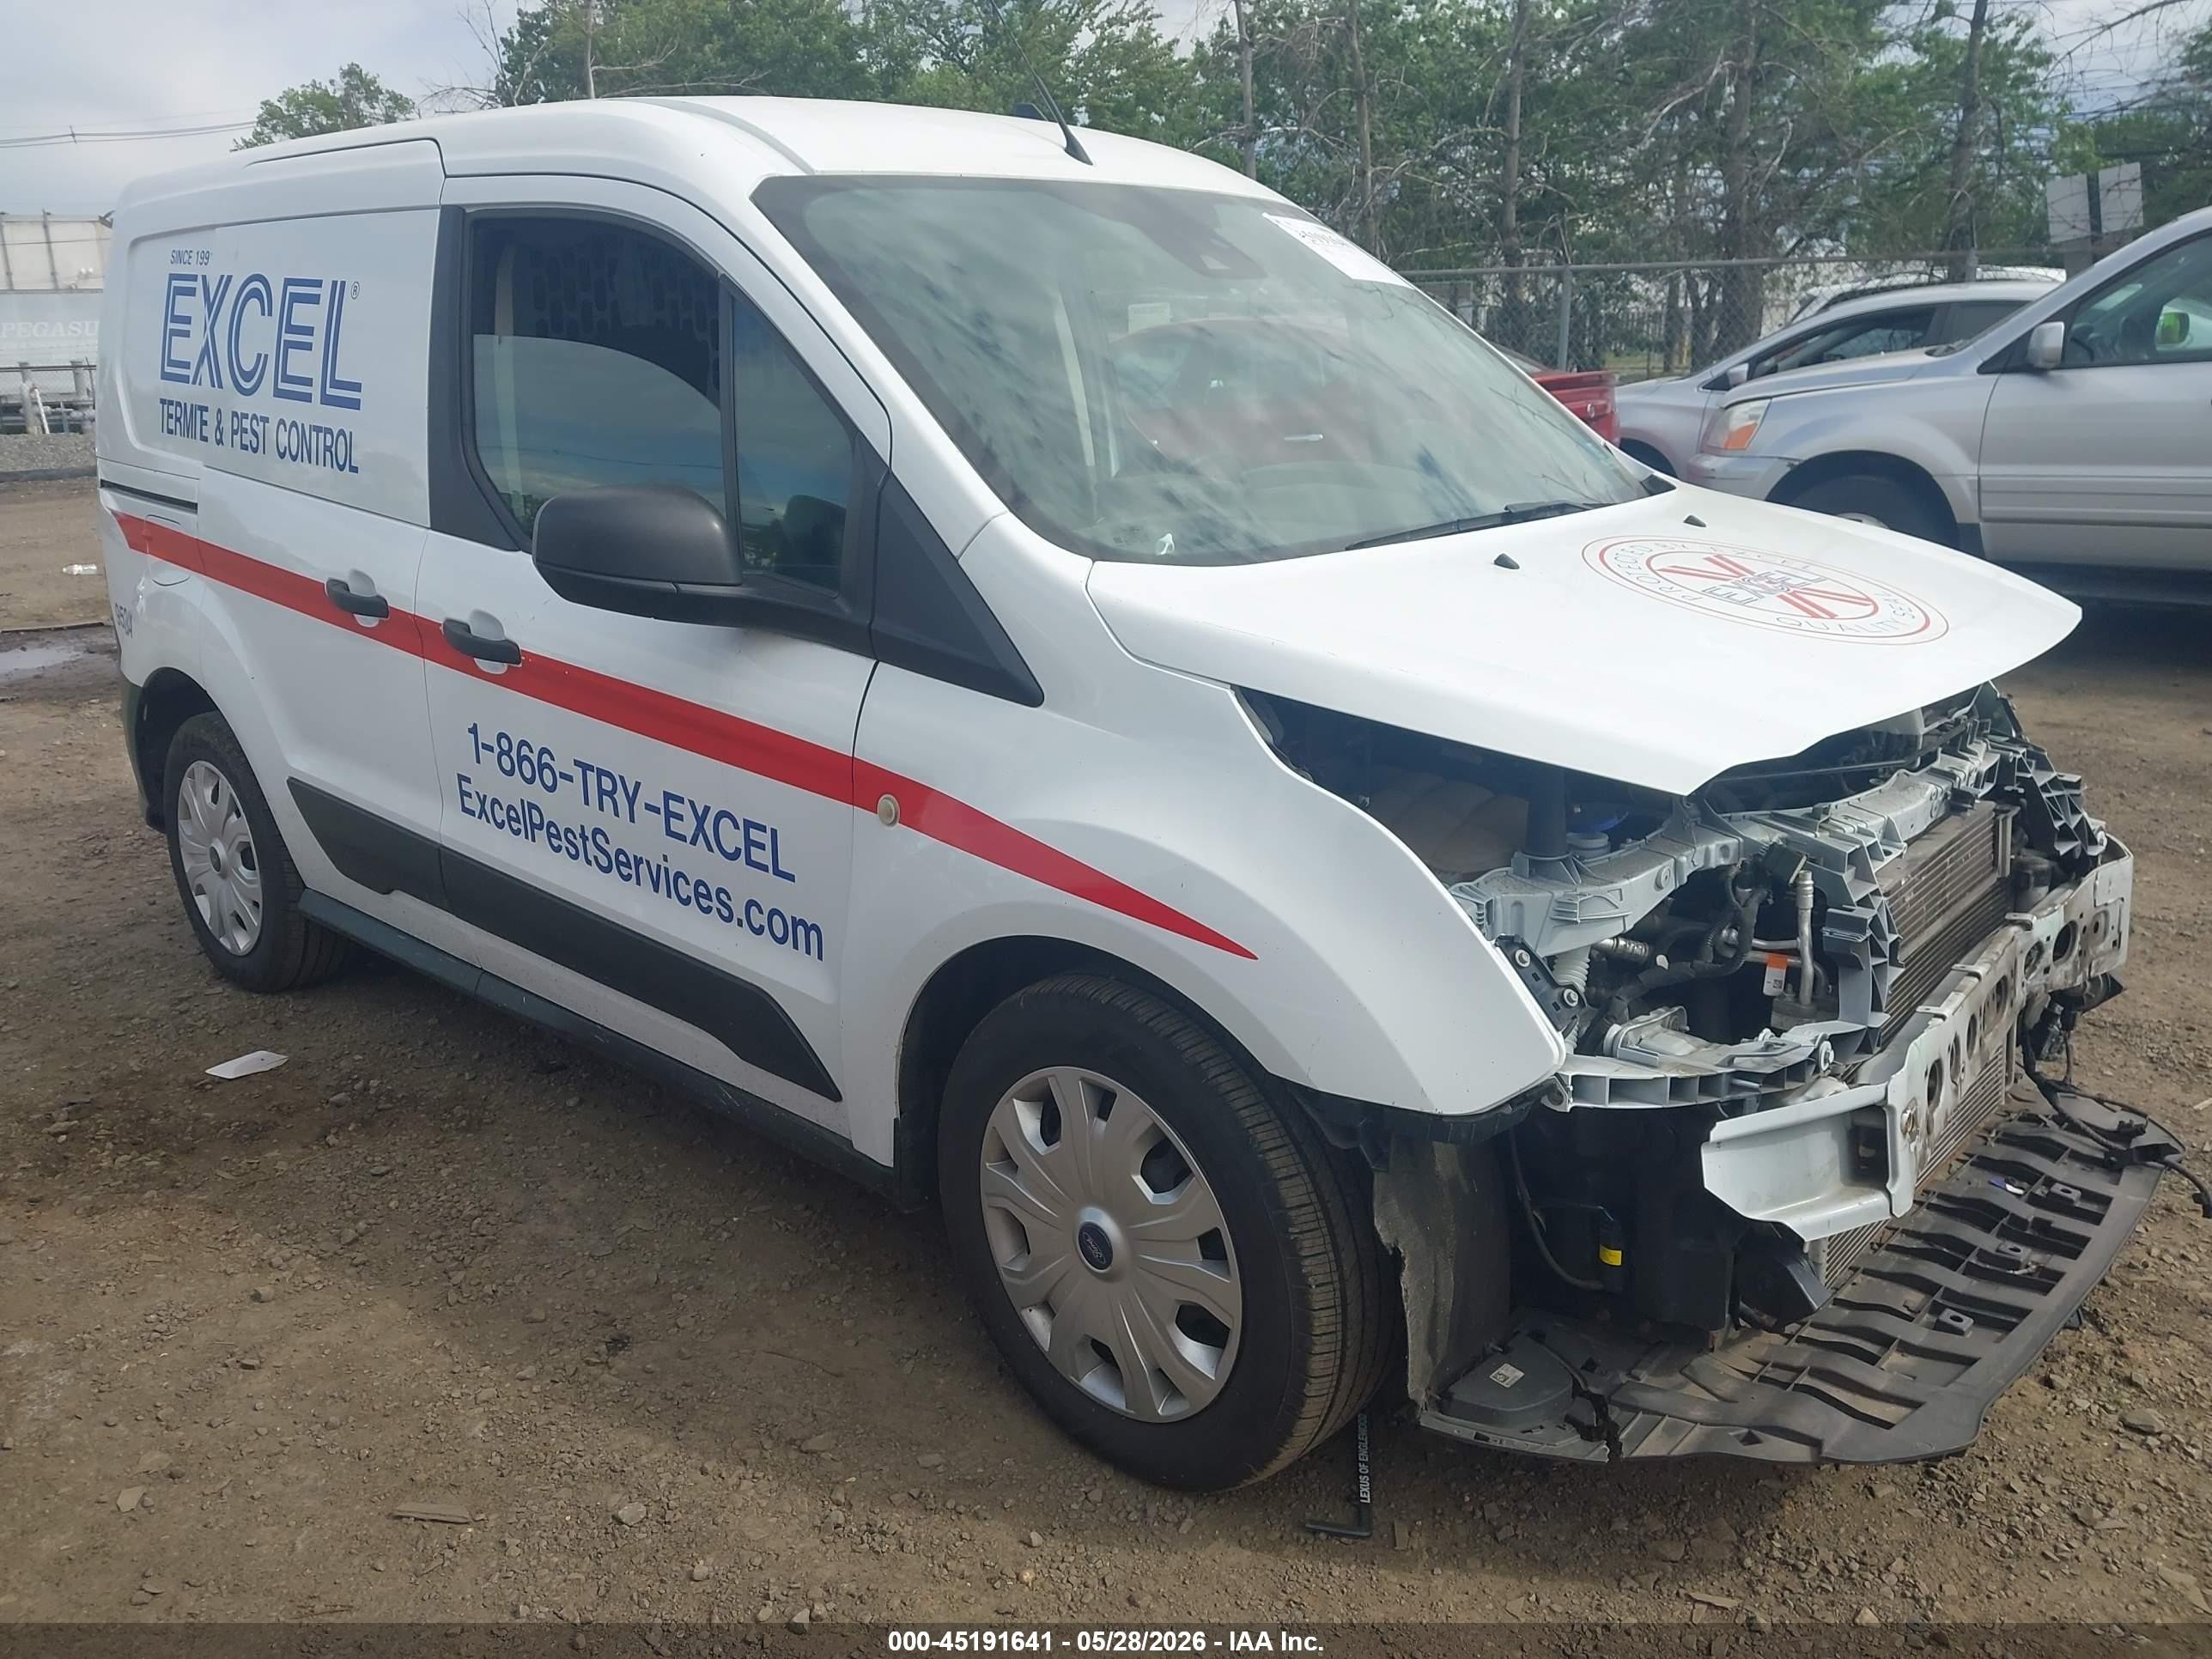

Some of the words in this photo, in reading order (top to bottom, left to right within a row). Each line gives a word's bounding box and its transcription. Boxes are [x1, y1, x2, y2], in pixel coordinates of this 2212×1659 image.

[170, 249, 192, 265] SINCE
[161, 273, 362, 410] EXCEL
[215, 407, 224, 447] &
[231, 410, 270, 456] PEST
[276, 418, 359, 474] CONTROL
[1701, 569, 1827, 605] EXCEL
[468, 722, 796, 883] 1-866-TRY-EXCEL
[457, 772, 823, 962] ExcelPestServices.com
[1358, 1462, 1370, 1474] OF
[1359, 1475, 1371, 1504] LEXUS
